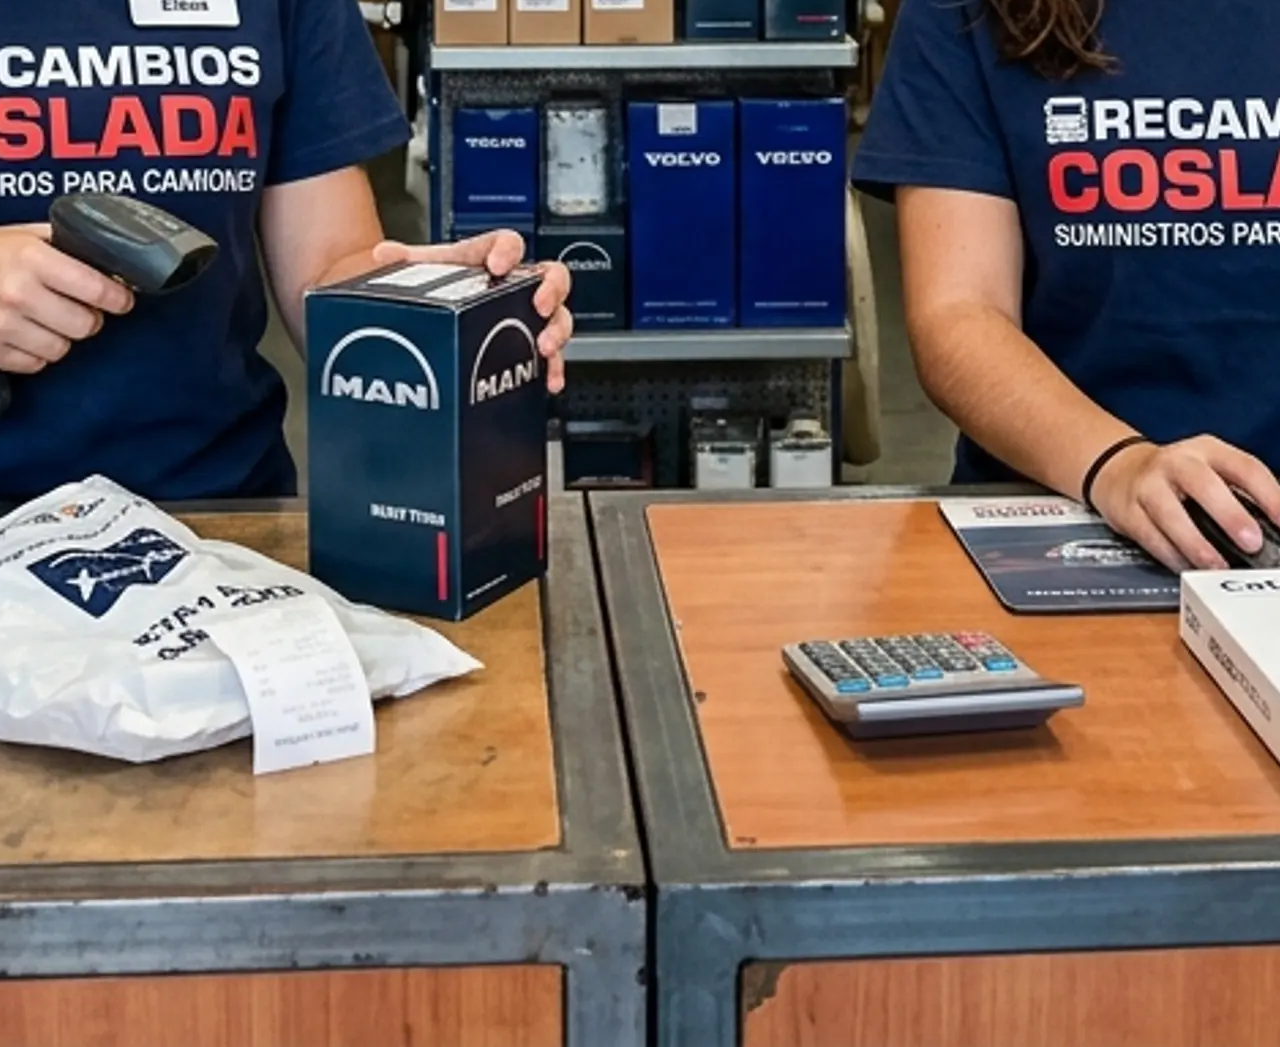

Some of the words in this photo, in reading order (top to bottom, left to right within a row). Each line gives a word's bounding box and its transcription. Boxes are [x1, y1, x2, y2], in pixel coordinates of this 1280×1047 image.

[64, 171, 135, 198] PARA
[1055, 223, 1224, 246] SUMINISTROS
[332, 373, 429, 410] MAN
